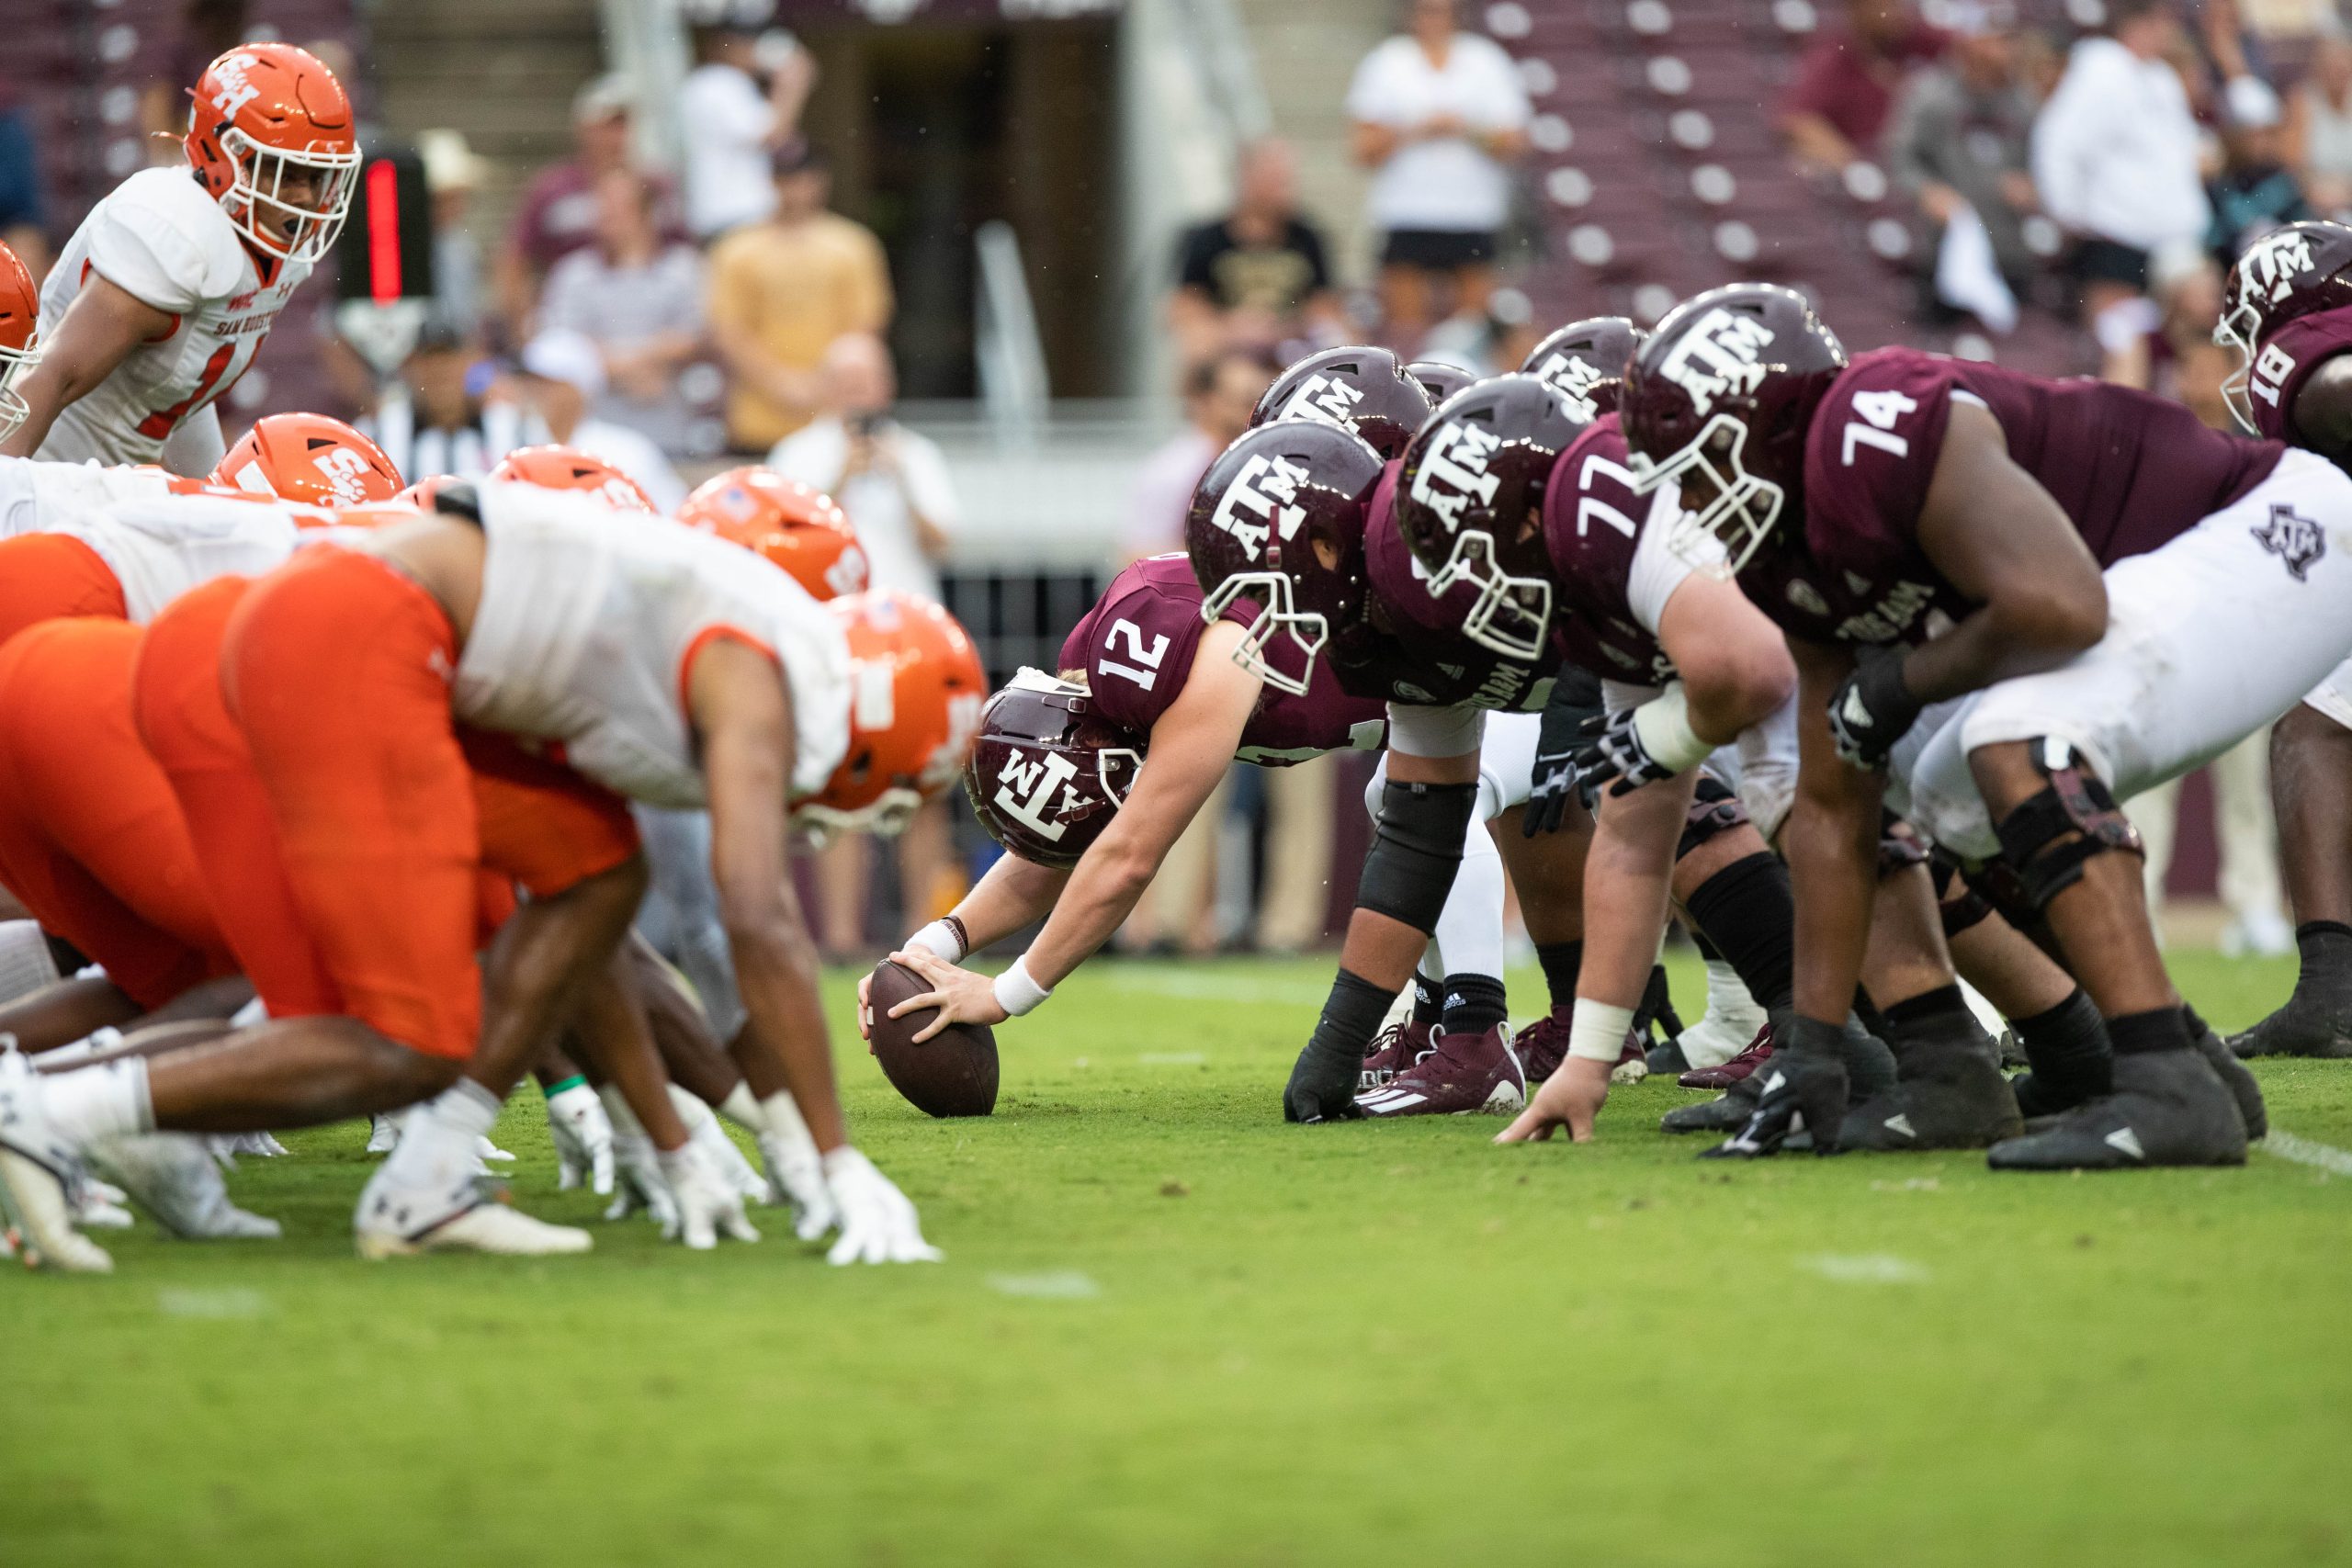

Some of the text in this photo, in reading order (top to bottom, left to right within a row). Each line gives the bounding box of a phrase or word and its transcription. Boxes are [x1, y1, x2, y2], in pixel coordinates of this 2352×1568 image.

[2251, 343, 2296, 409] 18
[1842, 389, 1918, 467] 74
[1577, 454, 1638, 539] 77
[1098, 618, 1170, 692] 12
